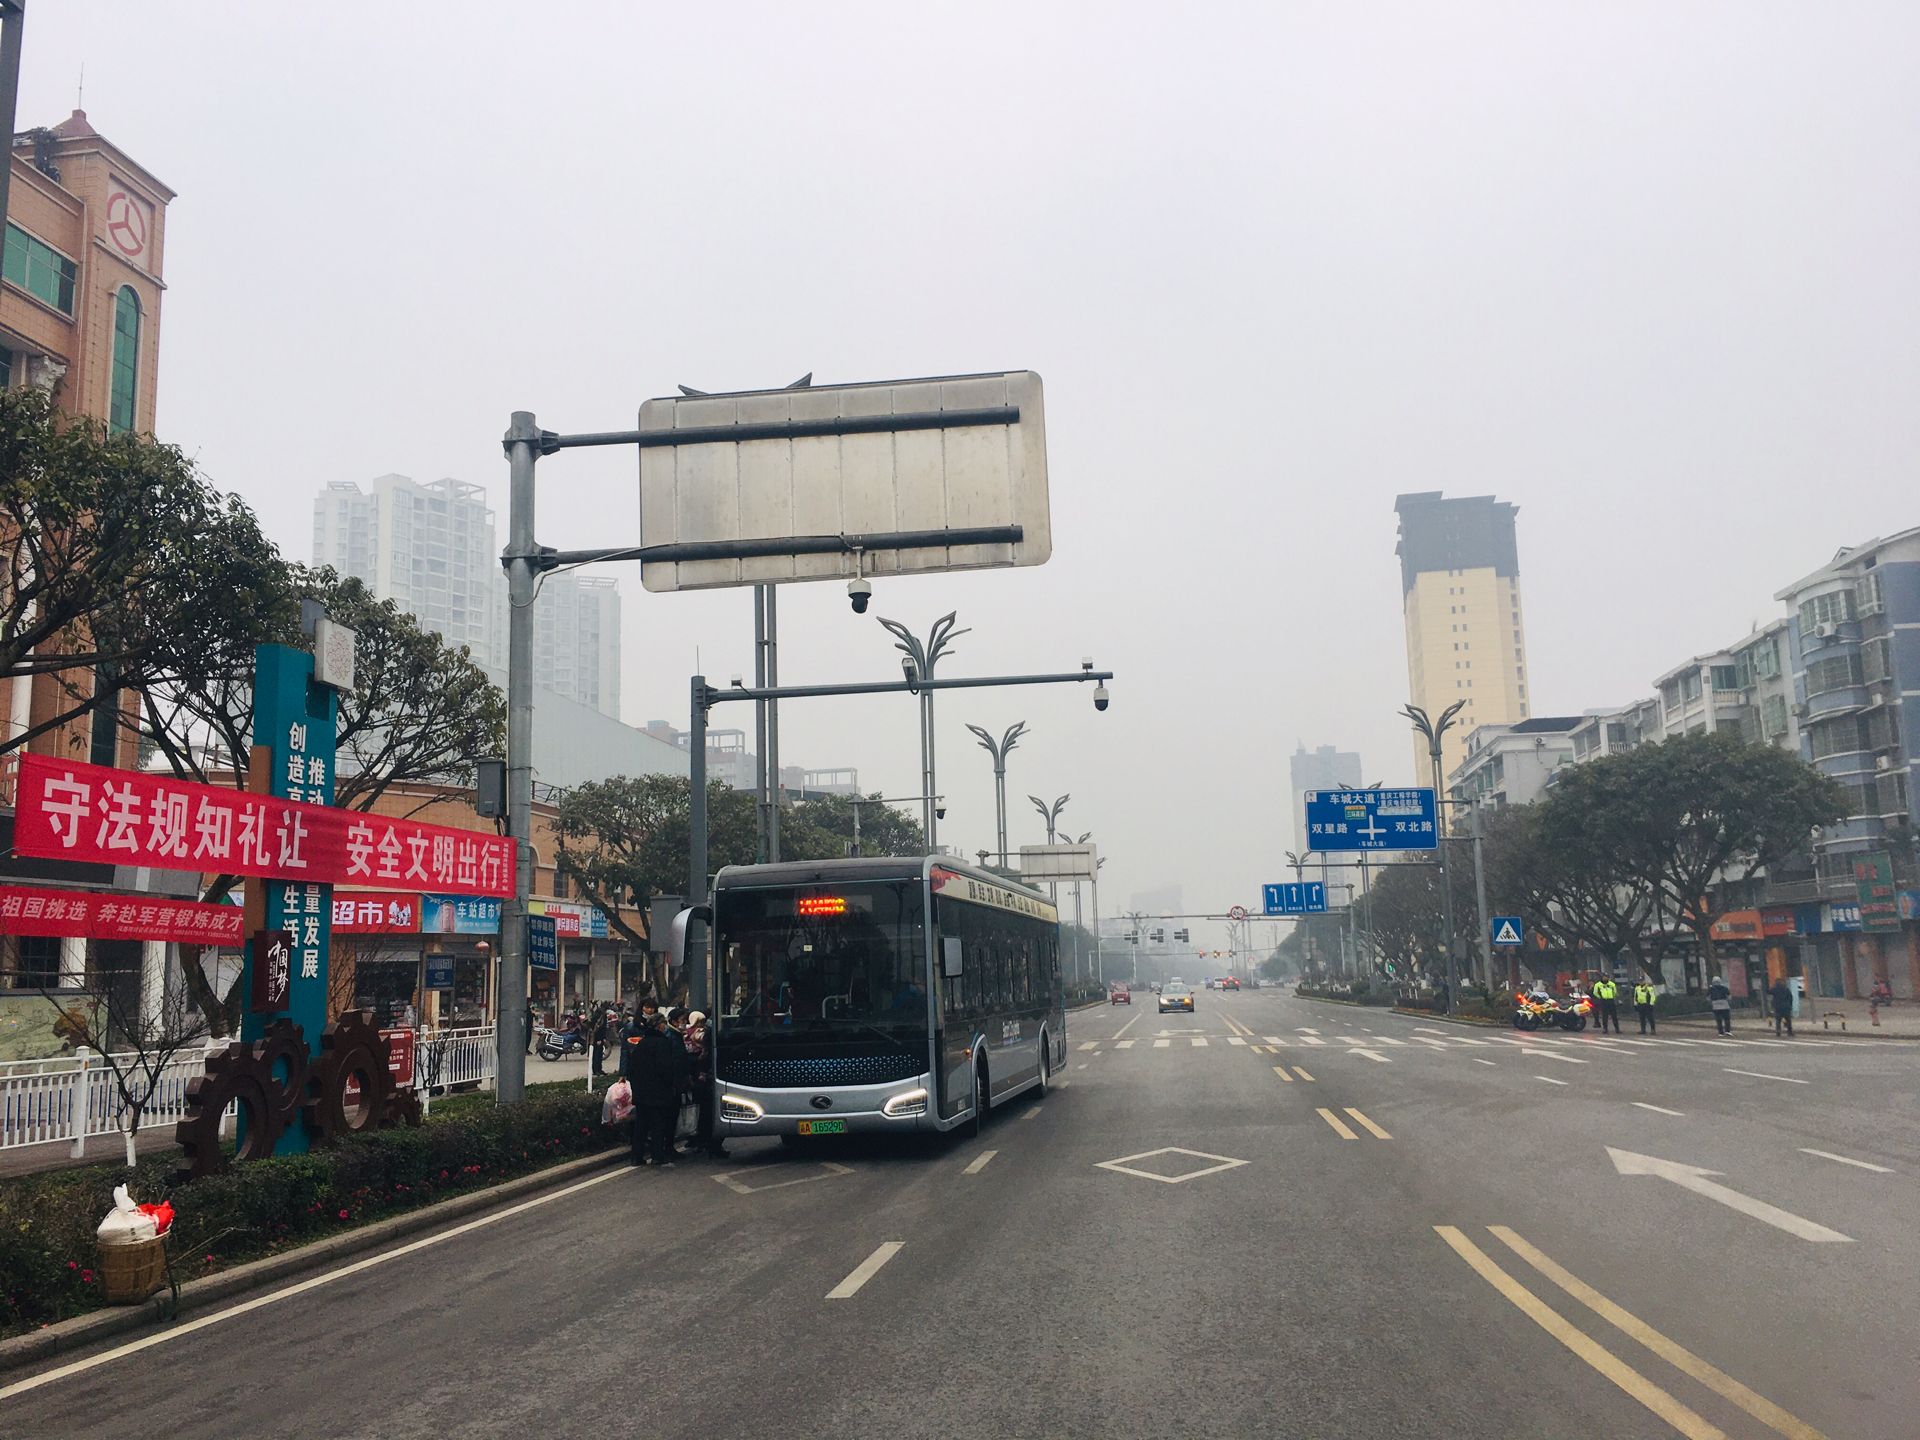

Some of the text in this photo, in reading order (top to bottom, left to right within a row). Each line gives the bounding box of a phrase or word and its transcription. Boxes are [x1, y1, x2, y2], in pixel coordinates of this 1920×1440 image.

[1329, 793, 1376, 805] 车城大道
[41, 772, 308, 869] 守法规知礼让
[346, 820, 500, 889] 安全文明出行
[1311, 823, 1348, 834] 双星路
[1395, 821, 1433, 833] 双北路
[0, 895, 244, 932] 祖国挑选 奔赴军营锻炼成才
[332, 900, 383, 925] 超市
[457, 901, 495, 919] 车站超市
[267, 940, 289, 1003] 中国梦
